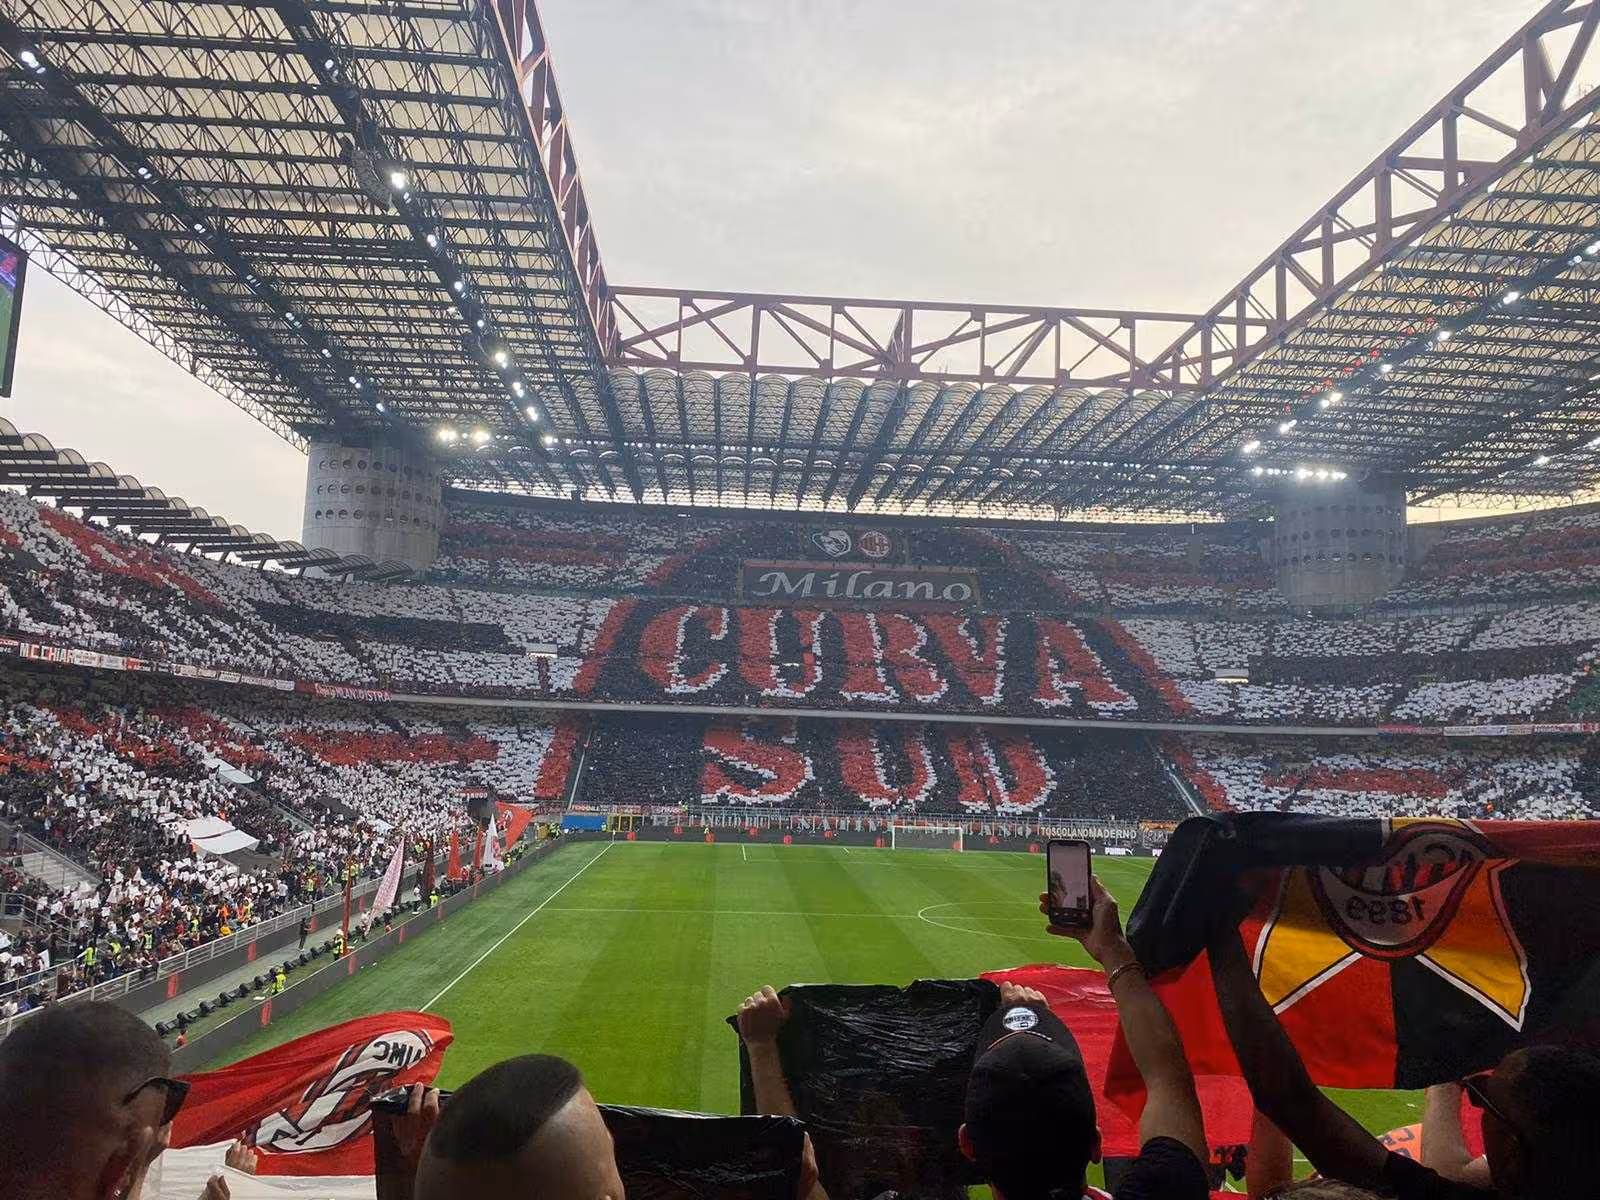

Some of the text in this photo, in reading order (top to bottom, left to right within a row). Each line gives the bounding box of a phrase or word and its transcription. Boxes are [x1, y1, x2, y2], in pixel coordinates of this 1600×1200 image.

[753, 570, 972, 602] Milano
[640, 605, 1138, 716] CURVA
[700, 719, 1057, 814] SUD
